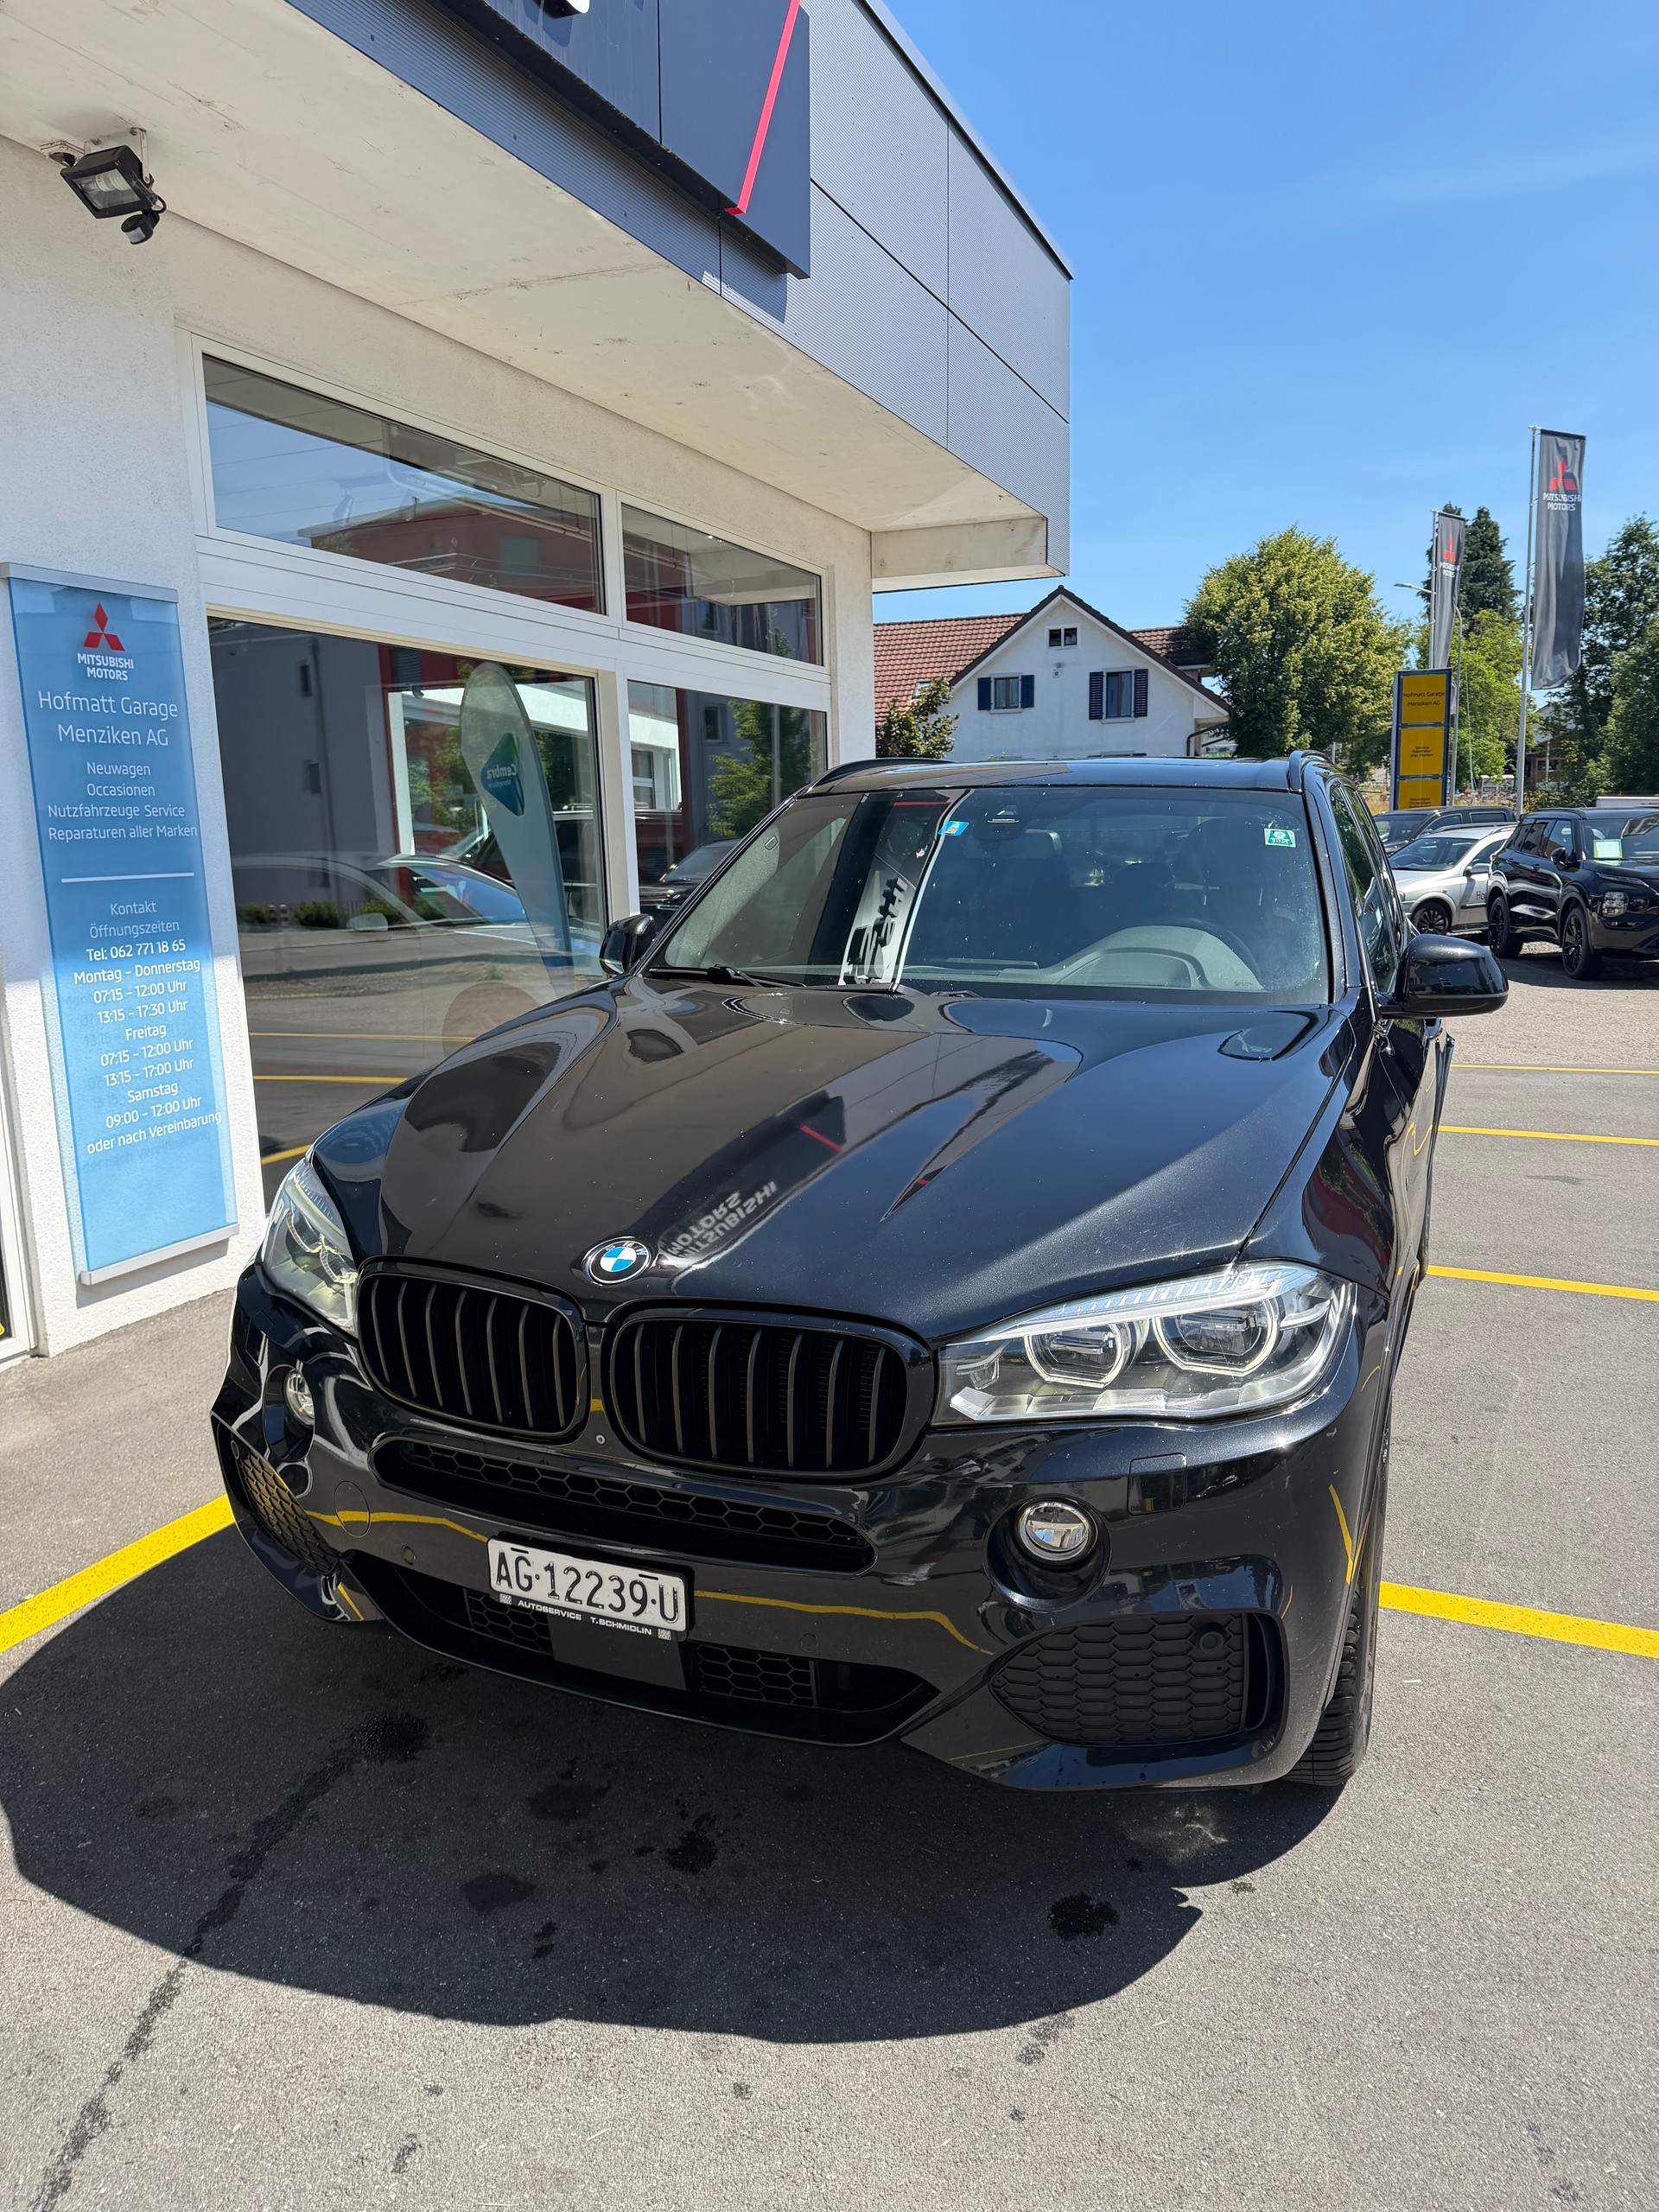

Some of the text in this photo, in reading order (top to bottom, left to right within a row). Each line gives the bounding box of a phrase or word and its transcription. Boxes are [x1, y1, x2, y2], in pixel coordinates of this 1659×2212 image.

[1547, 501, 1576, 512] MOTORS
[77, 652, 135, 670] MITSUBISHI
[86, 666, 129, 681] MOTORS
[38, 690, 179, 721] Hofmatt Garage
[57, 723, 168, 747] Menziken AG
[86, 761, 151, 779] Neuwagen
[86, 783, 156, 797] Occasionen
[48, 804, 186, 820] Nutzfahrzeuge Service
[48, 824, 198, 842] Reparaturen aller Marken
[110, 900, 157, 916] Kontakt
[89, 918, 180, 939] Öffnungszeiten
[110, 944, 134, 959] 062
[136, 942, 156, 957] 771
[156, 940, 170, 955] 18
[171, 938, 187, 953] 65
[73, 967, 123, 985] Montag
[135, 958, 201, 979] Donnerstag
[93, 988, 124, 1004] 07:15
[135, 983, 165, 998] 12:00
[168, 980, 188, 993] Uhr
[97, 1008, 125, 1024] 13:15
[137, 1003, 165, 1019] 17:30
[168, 1000, 188, 1014] Uhr
[125, 1024, 167, 1040] Freitag
[100, 1049, 130, 1067] 07:15
[141, 1042, 171, 1058] 12:00
[174, 1039, 194, 1052] Uhr
[104, 1071, 131, 1087] 13:15
[143, 1062, 172, 1078] 17:00
[175, 1058, 194, 1072] Uhr
[127, 1082, 179, 1103] Samstag
[105, 1110, 139, 1128] 09:00
[150, 1101, 180, 1117] 12:00
[182, 1096, 202, 1110] Uhr
[87, 1112, 222, 1154] oder nach Vereinbarung
[518, 1599, 582, 1621] AUTOSERVICE
